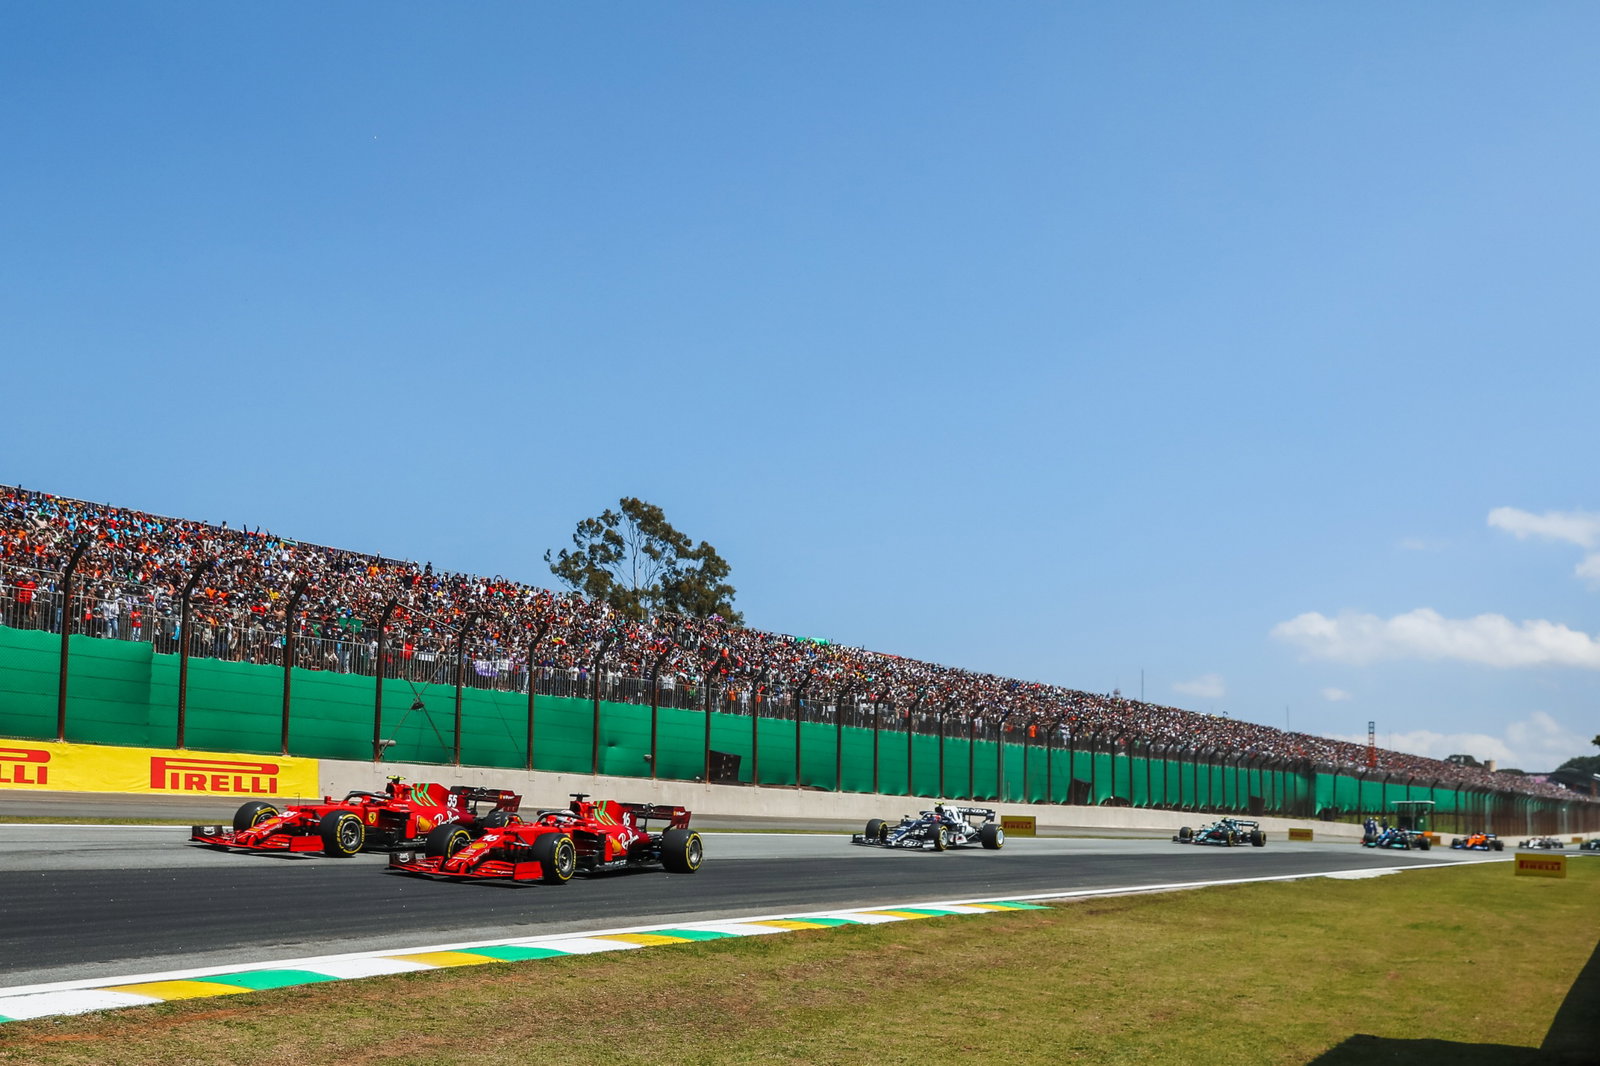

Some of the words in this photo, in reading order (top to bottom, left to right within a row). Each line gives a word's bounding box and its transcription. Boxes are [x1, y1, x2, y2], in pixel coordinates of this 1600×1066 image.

[150, 756, 280, 794] PIRELLI
[447, 794, 458, 807] 55
[622, 812, 631, 827] 16
[482, 834, 500, 842] 16
